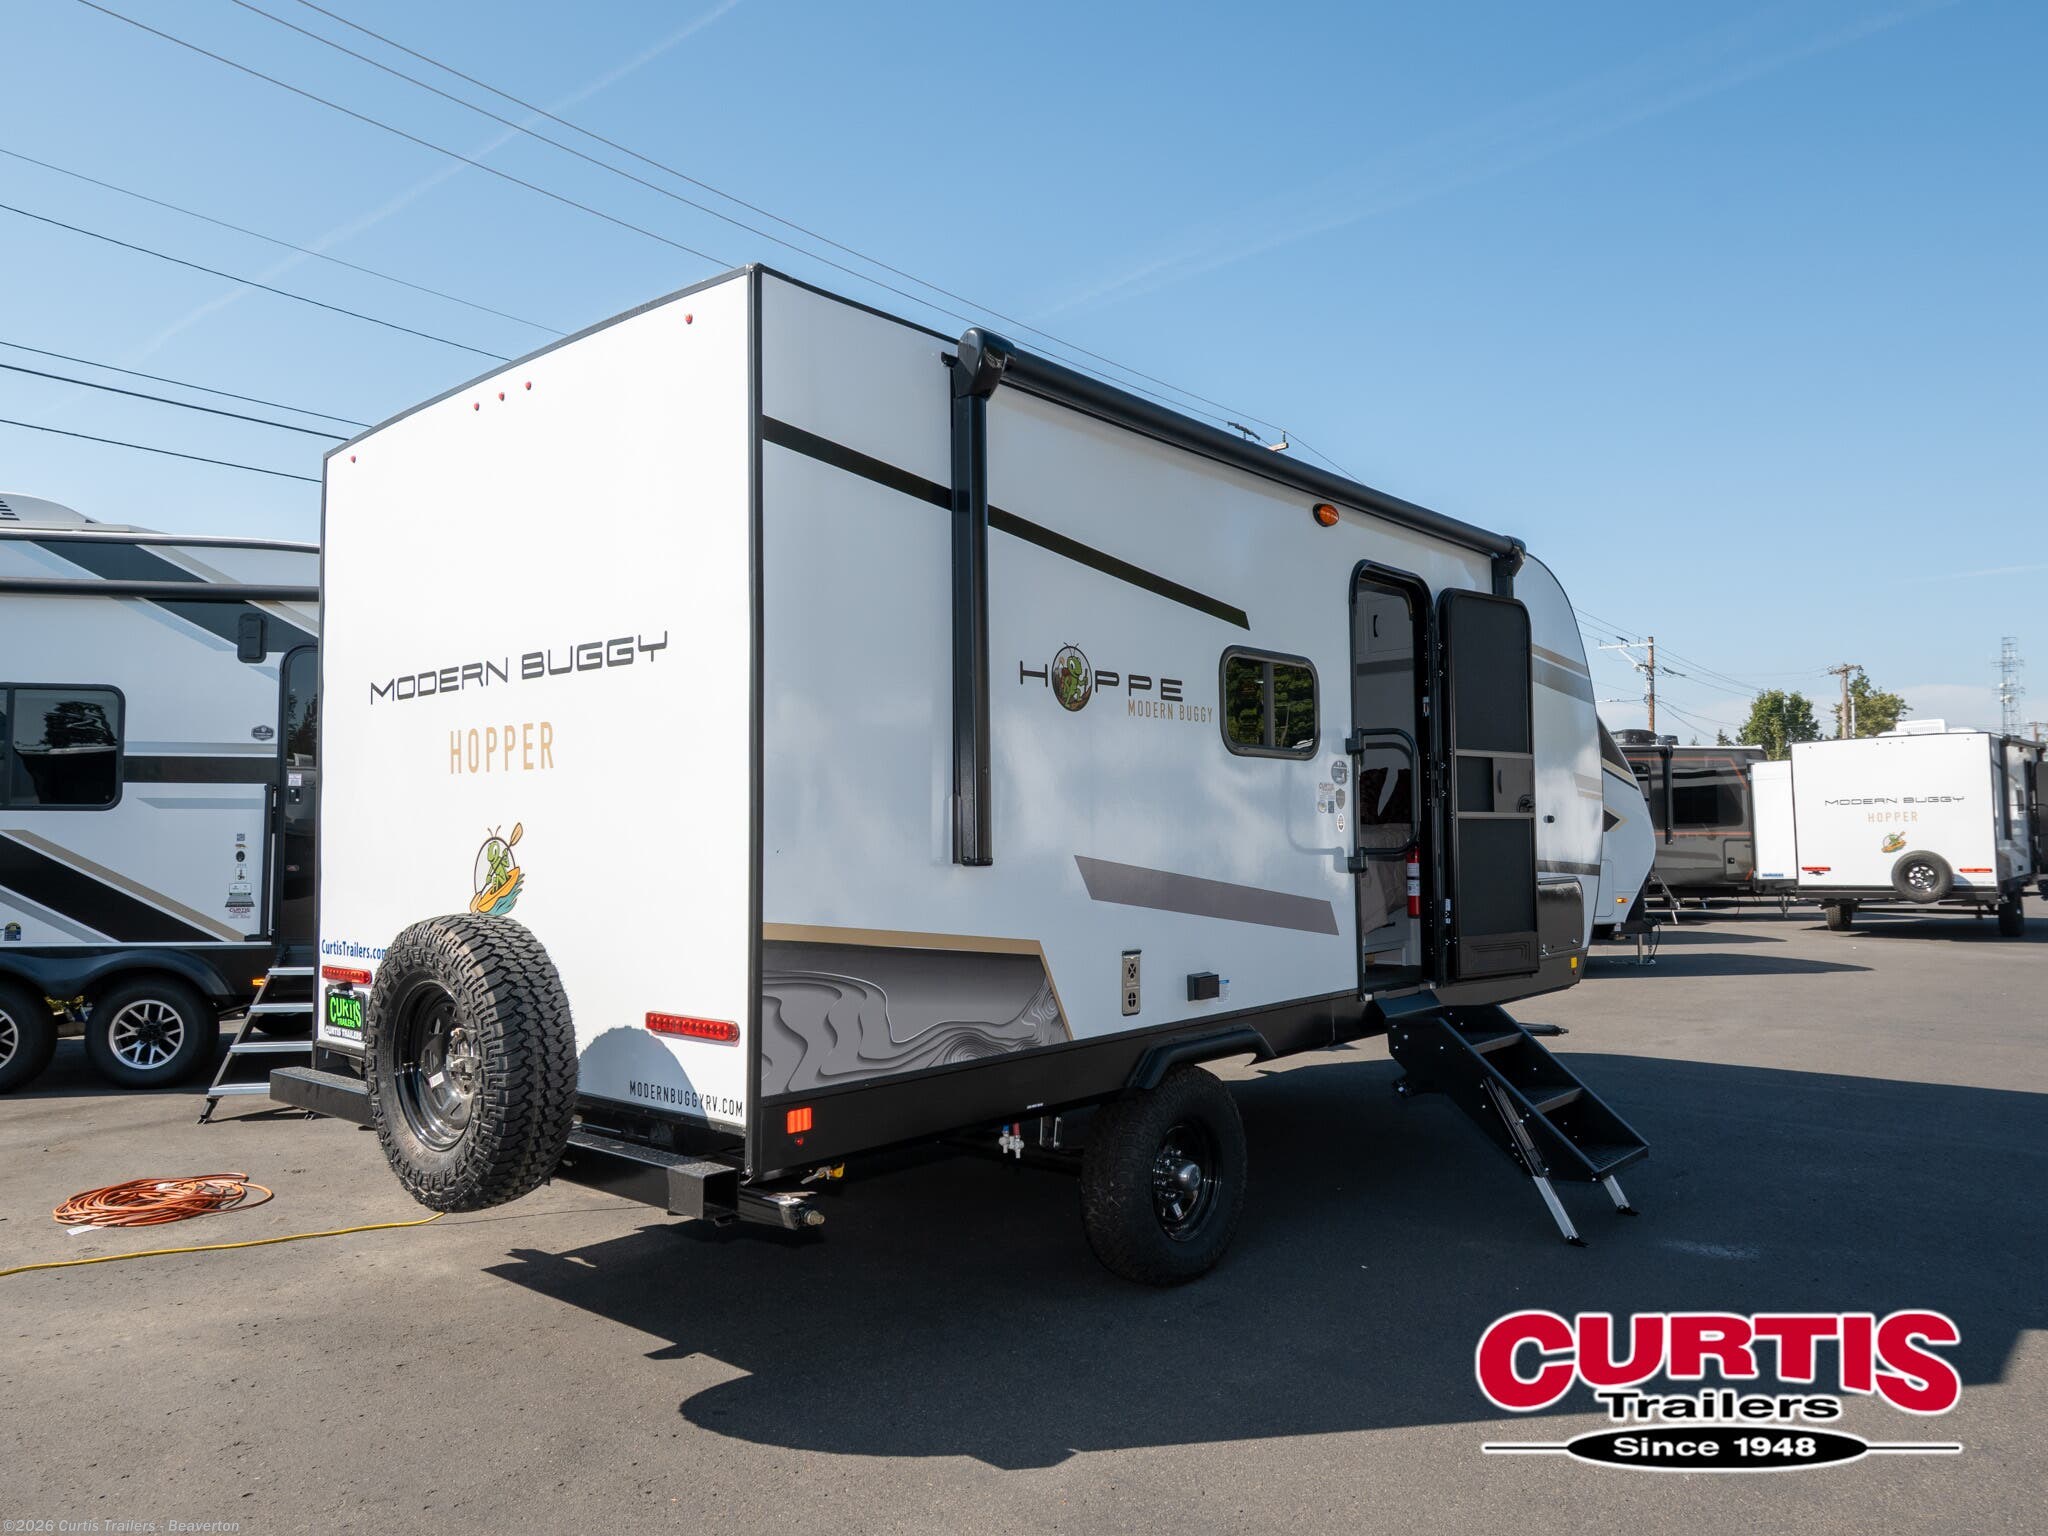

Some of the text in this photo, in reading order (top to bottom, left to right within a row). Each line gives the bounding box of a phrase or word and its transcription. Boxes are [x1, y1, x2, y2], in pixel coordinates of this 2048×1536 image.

[370, 630, 668, 705] MODERN BUGGY
[1128, 700, 1213, 723] MODERN BUGGY
[450, 721, 554, 774] HOPPER
[1824, 796, 1965, 806] MODERN BUGGY
[1867, 811, 1918, 823] HOPPER
[330, 997, 361, 1028] CURTIS
[629, 1080, 743, 1118] MODERNBUGGYRV.COM
